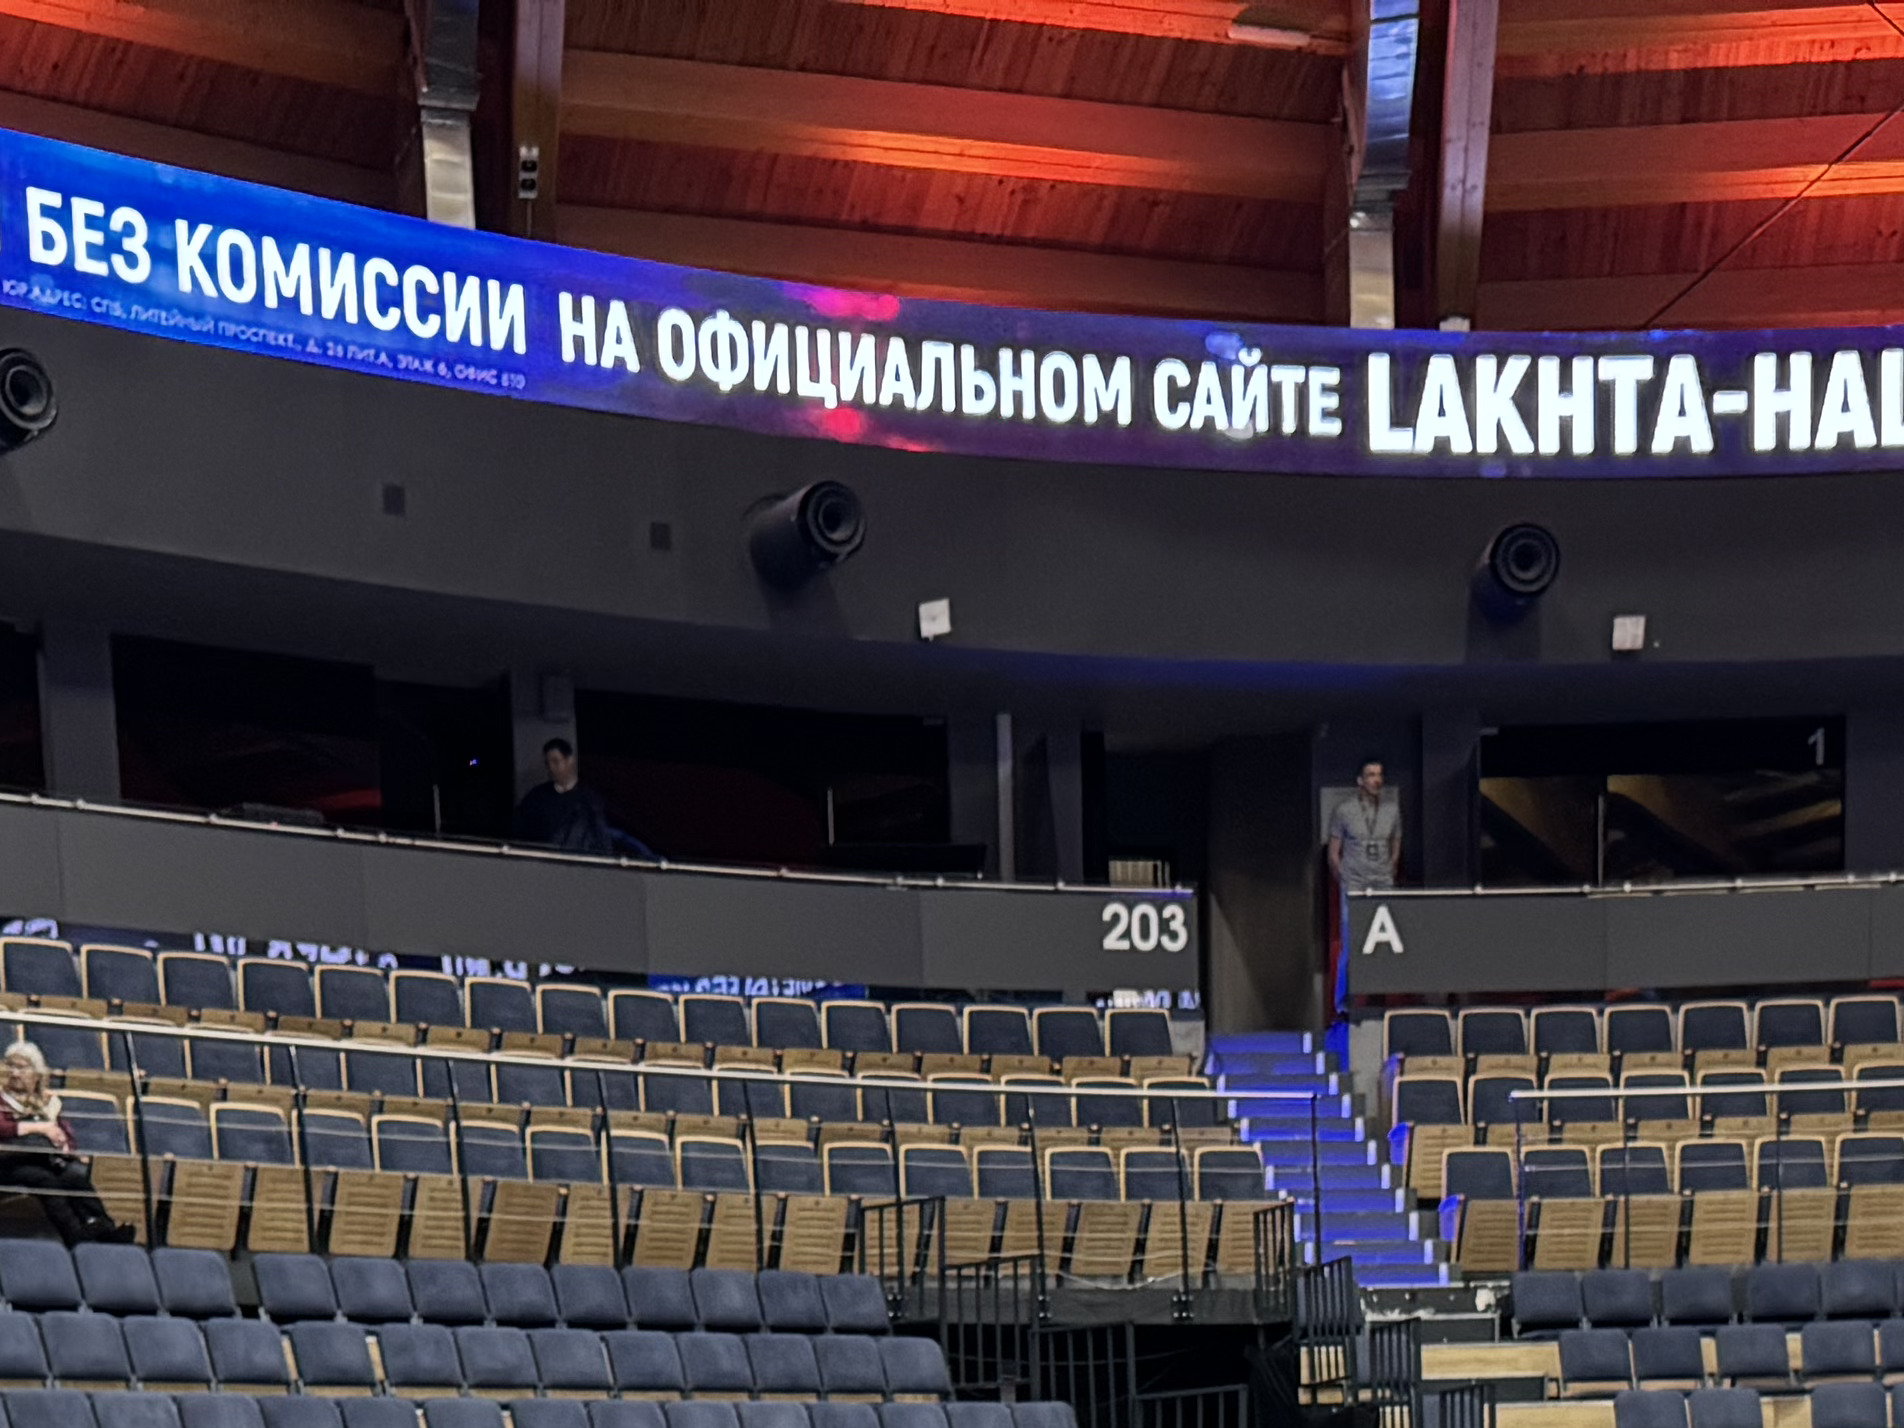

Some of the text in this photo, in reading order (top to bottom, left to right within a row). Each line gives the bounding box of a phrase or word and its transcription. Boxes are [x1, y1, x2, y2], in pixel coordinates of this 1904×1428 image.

[26, 186, 151, 284] БЕЗ
[175, 219, 526, 355] КОМИССИИ
[559, 291, 640, 373] НА
[658, 308, 1133, 427] ОФИЦИАЛЬНОМ
[1154, 348, 1342, 437] САЙТЕ
[1806, 728, 1827, 767] 1
[1101, 902, 1189, 953] 203
[1361, 904, 1405, 955] A
